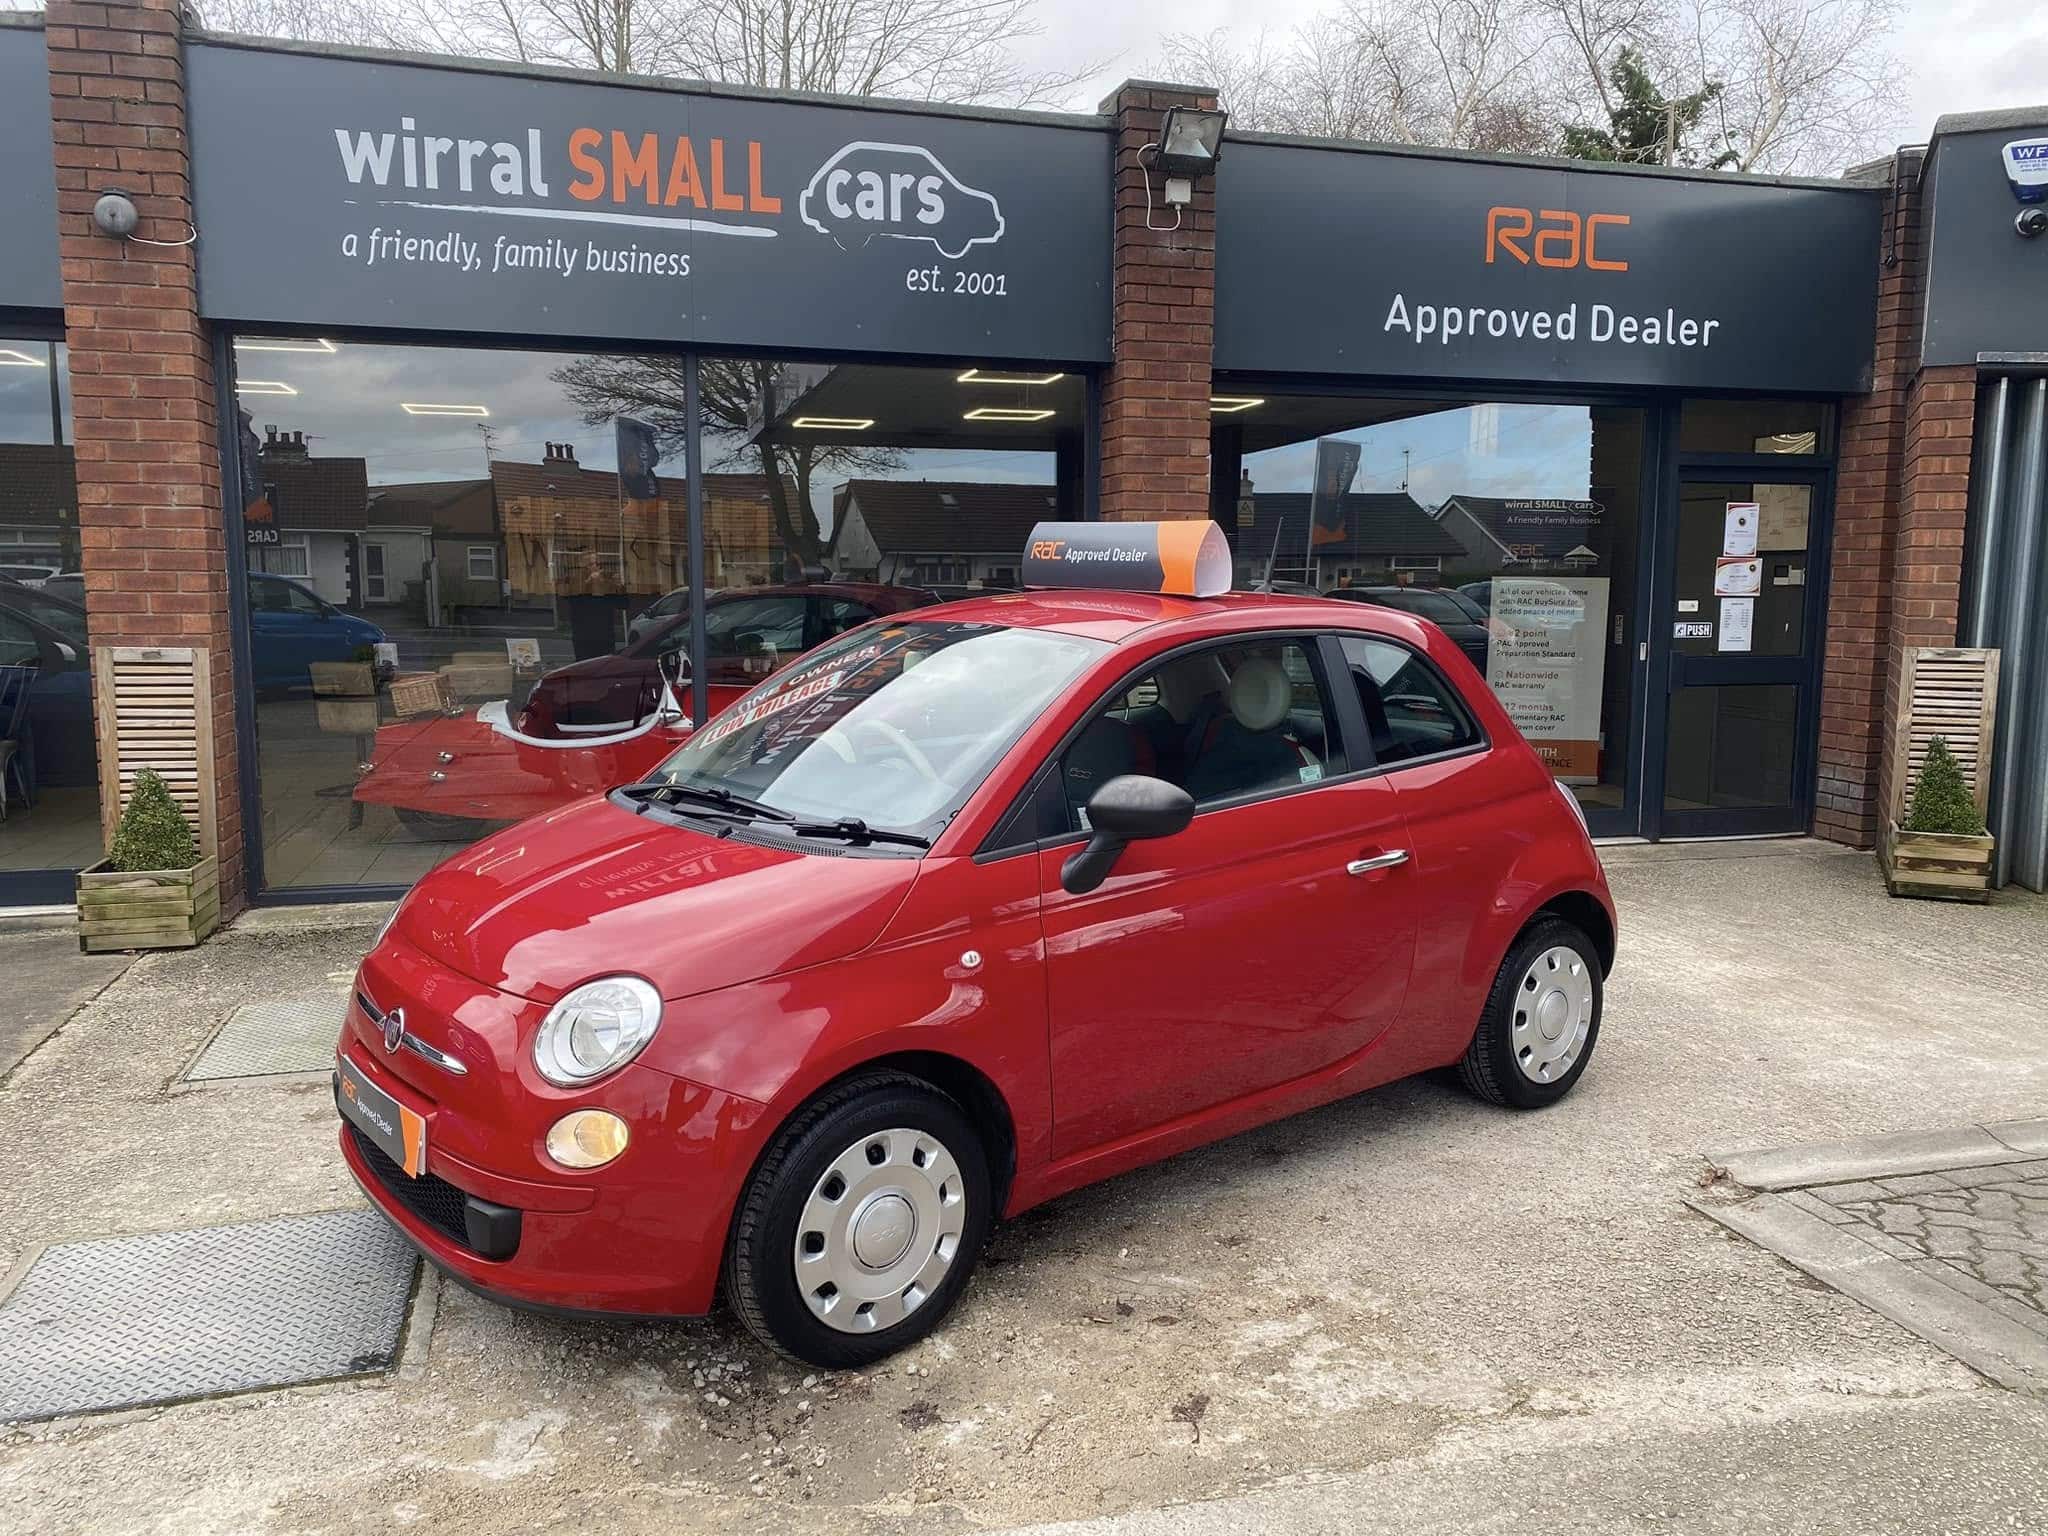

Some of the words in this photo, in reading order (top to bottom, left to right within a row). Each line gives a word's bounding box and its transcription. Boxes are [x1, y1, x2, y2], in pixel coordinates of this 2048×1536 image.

[334, 117, 549, 198] wirral
[567, 127, 782, 214] SMALL
[826, 167, 946, 226] cars
[341, 232, 358, 258] a
[366, 227, 481, 270] friendly,
[492, 234, 579, 277] family
[586, 239, 691, 277] business
[905, 268, 946, 293] est.
[953, 271, 1009, 297] 2001
[1383, 293, 1577, 344] Approved
[1590, 304, 1720, 347] Dealer
[1504, 500, 1533, 509] wirral
[1535, 500, 1568, 509] SMALL
[1574, 502, 1594, 510] cars
[1065, 547, 1111, 564] Approved
[1112, 548, 1148, 563] Dealer
[1517, 598, 1532, 606] RAC
[1523, 629, 1547, 640] point
[1687, 624, 1711, 636] PUSH
[1514, 640, 1550, 650] Approved
[1496, 649, 1541, 659] Preparation
[1541, 650, 1576, 658] Standard
[788, 645, 878, 686] OWNER
[1505, 670, 1559, 680] Nationwide
[1494, 681, 1510, 689] RAC
[1511, 682, 1546, 690] warranty
[707, 713, 748, 744] LOW
[753, 674, 835, 721] MILEAGE
[1518, 703, 1555, 711] months
[356, 1095, 377, 1123] Approved
[376, 1113, 393, 1137] Dealer
